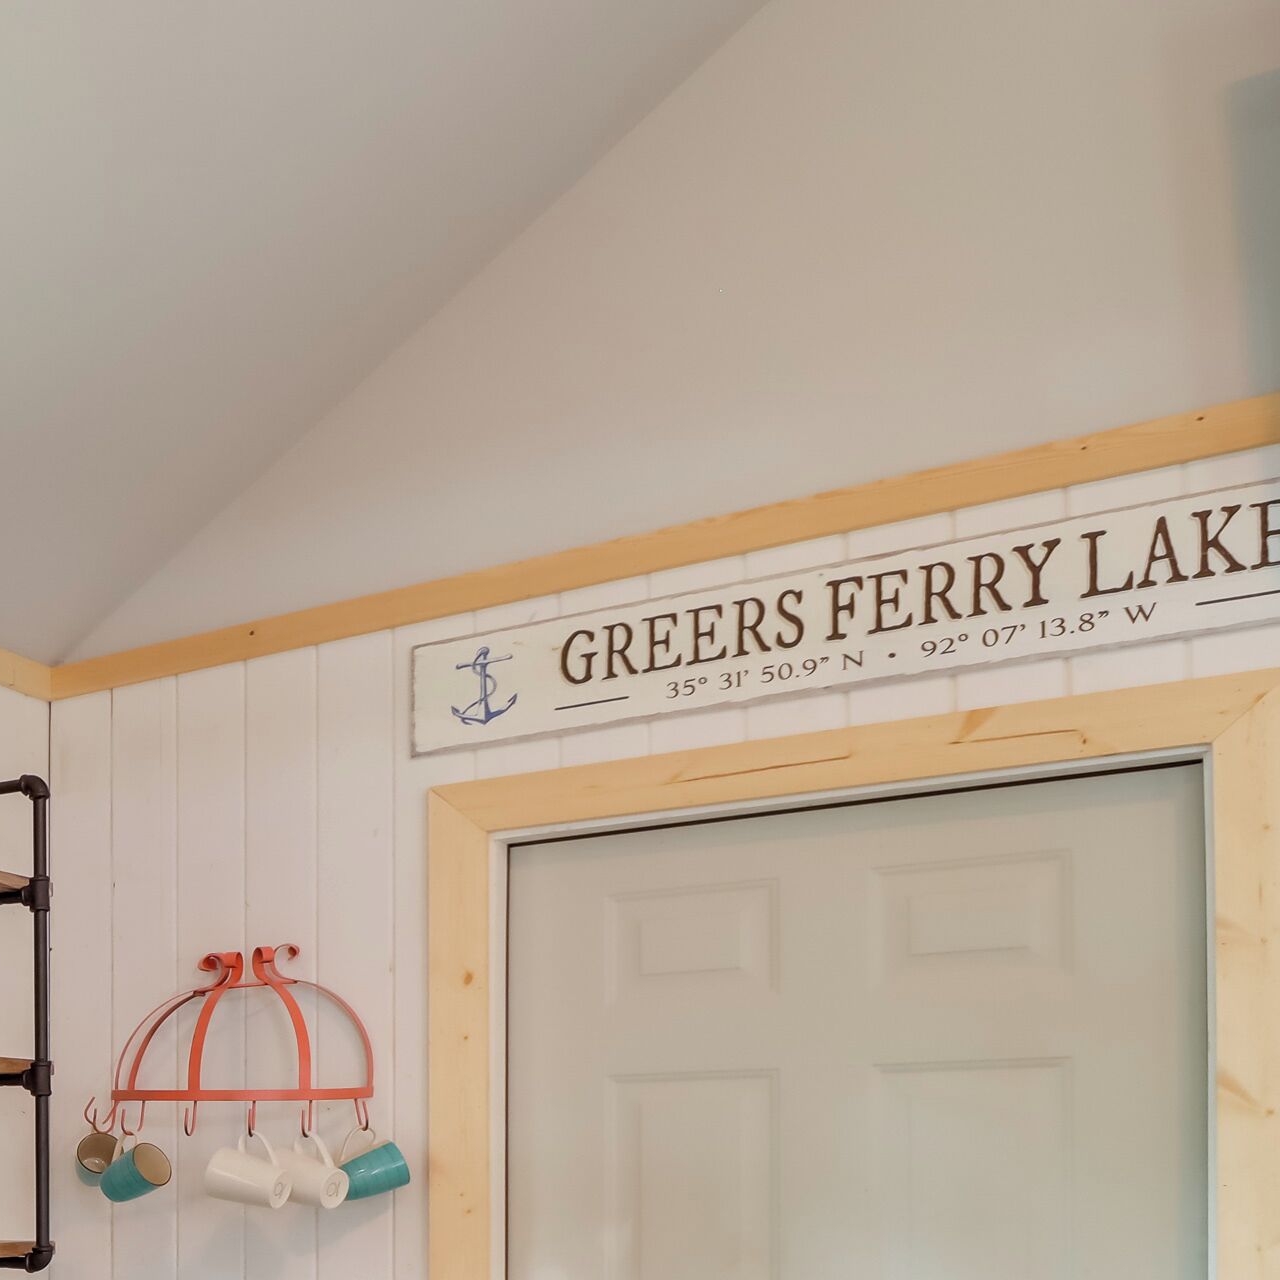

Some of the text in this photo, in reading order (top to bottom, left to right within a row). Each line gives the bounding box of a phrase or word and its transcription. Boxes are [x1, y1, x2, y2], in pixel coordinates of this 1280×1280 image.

[560, 589, 804, 686] GREERS
[825, 538, 1061, 642] FERRY
[665, 676, 708, 700] 35°
[841, 650, 865, 671] N
[920, 633, 969, 659] 92°
[1123, 602, 1157, 625] W
